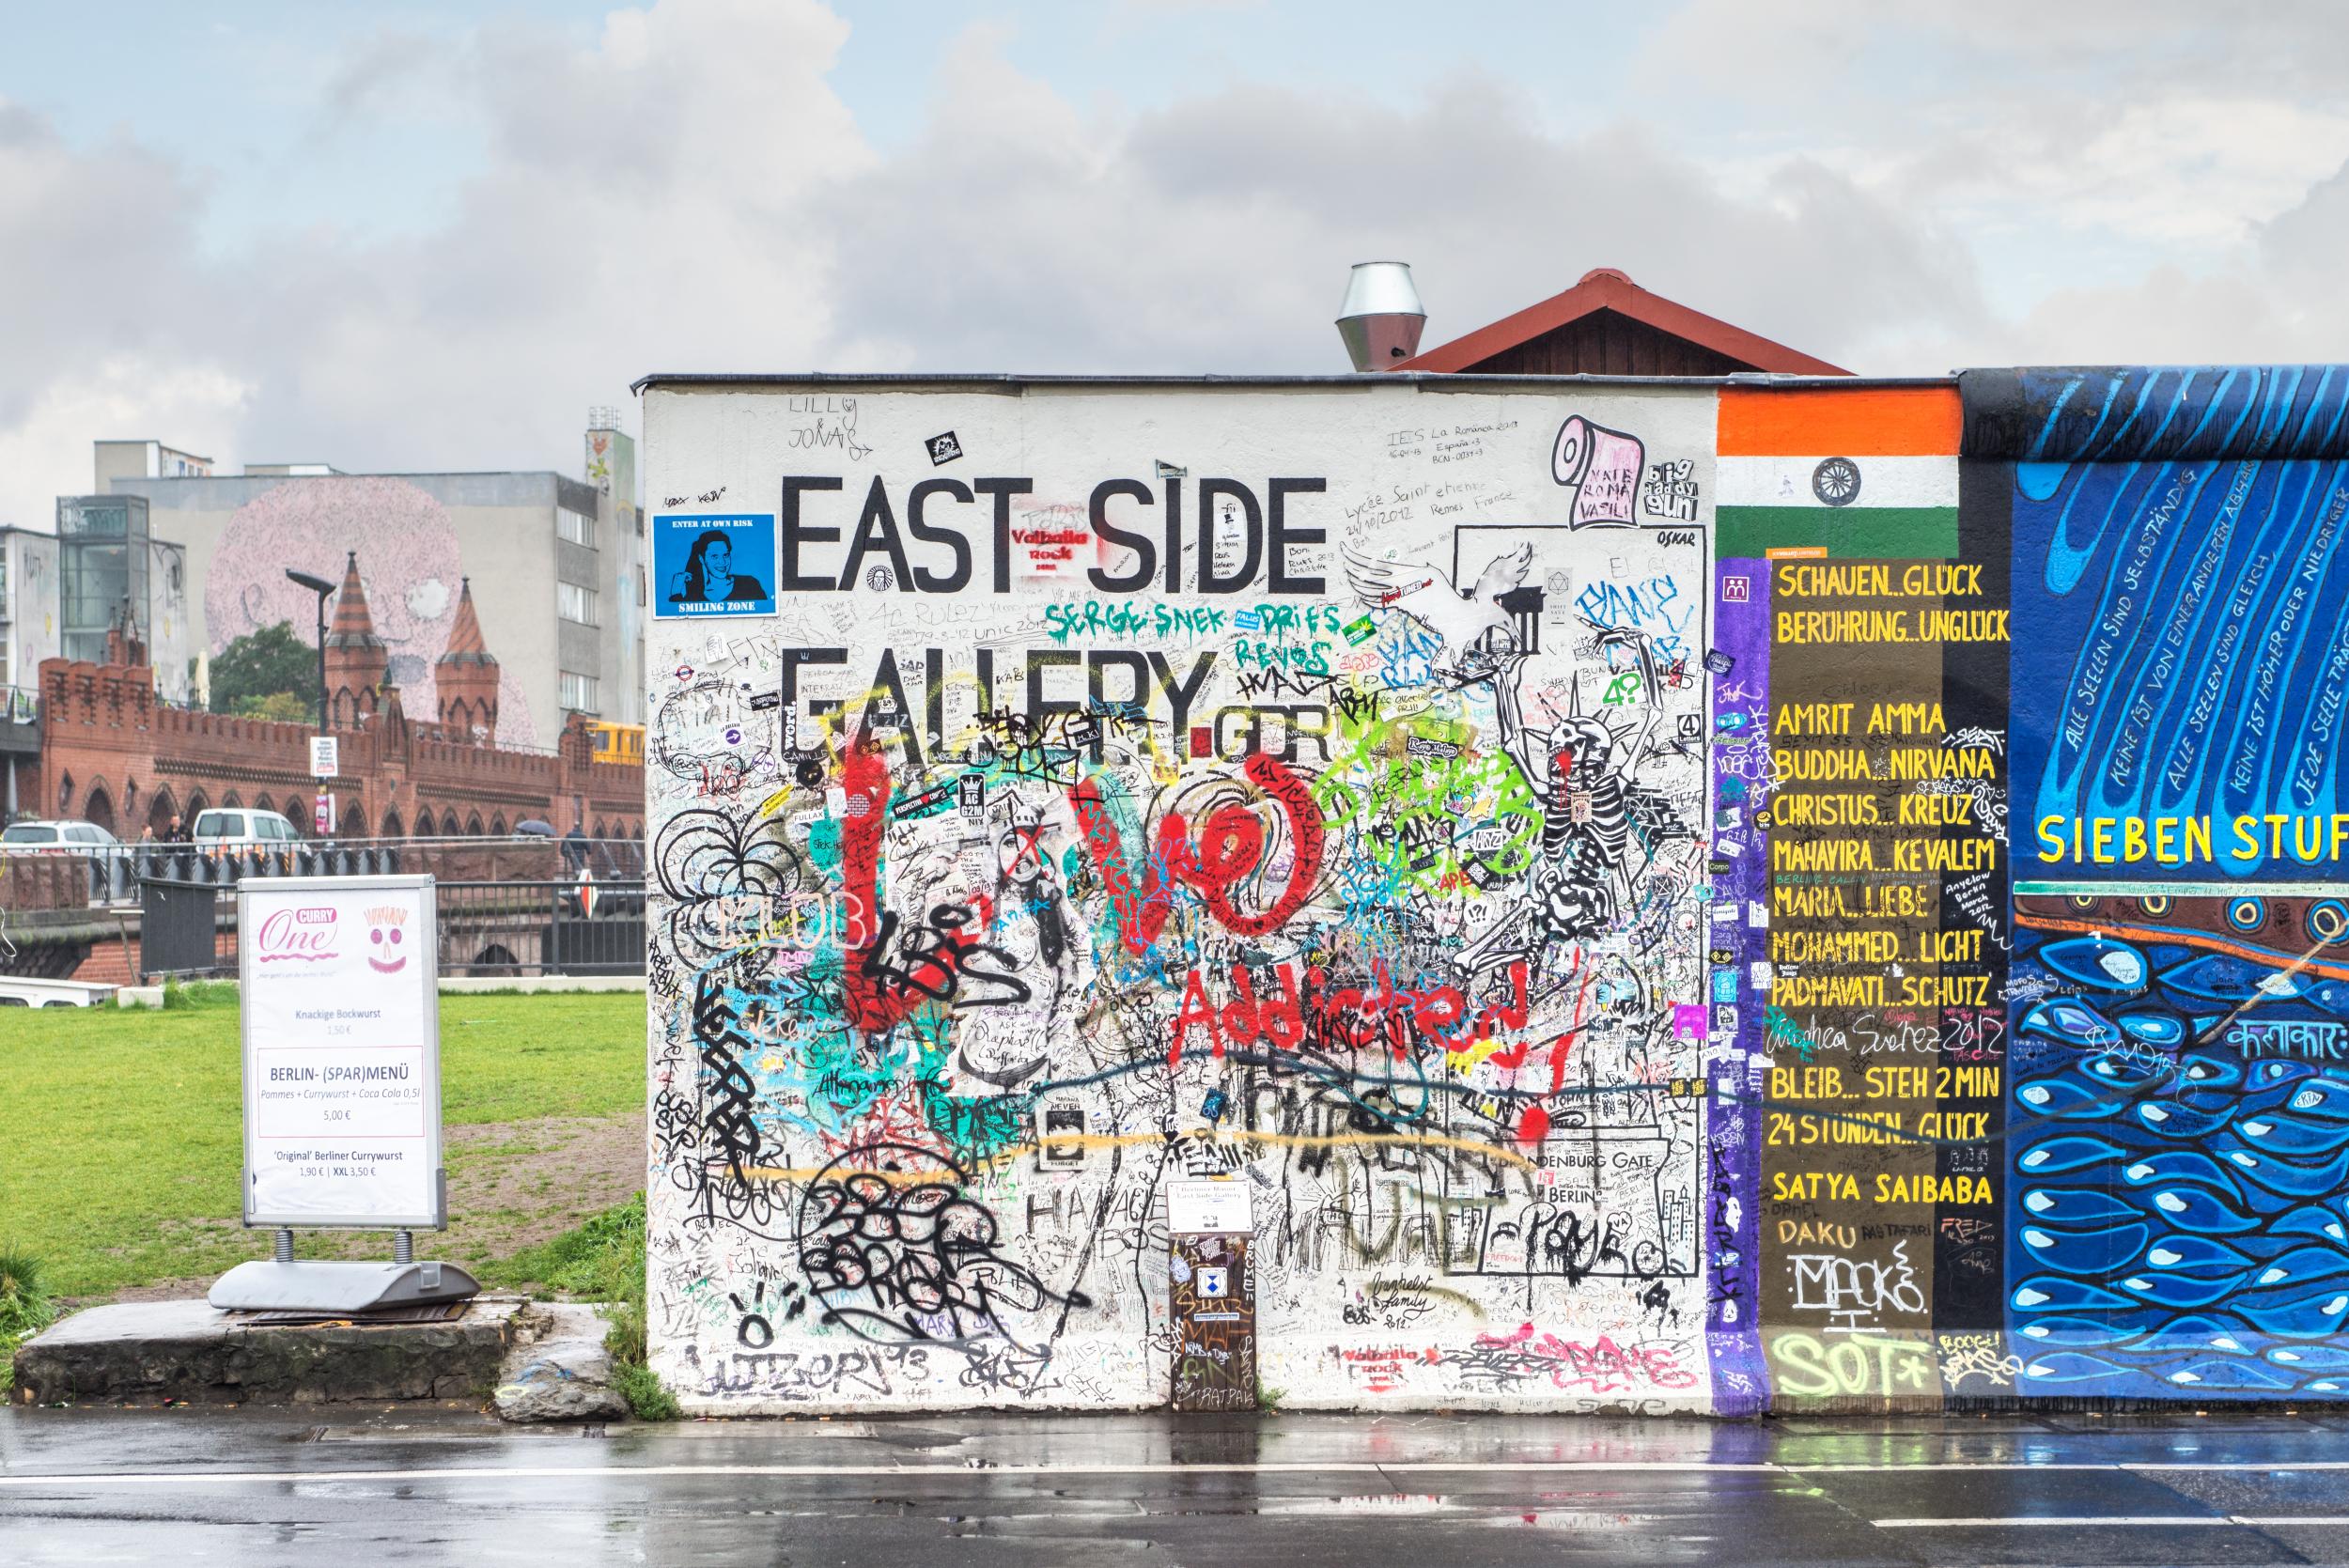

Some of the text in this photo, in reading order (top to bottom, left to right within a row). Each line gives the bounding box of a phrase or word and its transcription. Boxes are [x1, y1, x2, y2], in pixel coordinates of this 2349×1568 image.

[1648, 459, 1694, 482] big
[1644, 482, 1699, 497] daddy
[1645, 495, 1699, 520] gun
[782, 475, 1327, 594] EAST SIDE
[1657, 531, 1696, 548] OSKAR
[678, 601, 755, 613] SMILING ZONE
[2280, 586, 2308, 633] ODER
[2148, 645, 2174, 692] VON
[2066, 706, 2088, 753] ALLE
[2077, 640, 2112, 708] SEELEN
[1774, 703, 1946, 735] AMRIT AMMA
[2168, 737, 2195, 791] ALLE
[2195, 664, 2223, 734] SEELEN
[2295, 741, 2324, 808] JEDE
[2312, 683, 2342, 742] SEELE
[961, 805, 984, 817] G2M
[964, 794, 979, 805] AC
[1899, 793, 1972, 826] KREUZ
[794, 811, 824, 822] FULLAX
[2037, 815, 2212, 863] SIEBEN
[1709, 863, 1729, 872] Corpo
[299, 908, 334, 924] CURRY
[259, 908, 337, 952] One
[295, 1008, 381, 1021] Knackige Bockwurst
[1943, 1014, 2004, 1055] 2012
[271, 1063, 409, 1083] BERLIN- (SPAR)MENÜ
[1865, 1067, 1928, 1098] STEH
[1936, 1067, 1952, 1099] 2
[1956, 1067, 1999, 1098] MIN
[260, 1089, 295, 1099] Pommes
[303, 1088, 350, 1100] Currywurst
[359, 1088, 380, 1098] Coca
[381, 1088, 401, 1098] Cola
[323, 1110, 351, 1121] 5,00 €
[1768, 1112, 1796, 1145] 24
[315, 1151, 350, 1161] Berliner
[351, 1151, 403, 1162] Currywurst
[1611, 1151, 1654, 1169] GATE
[300, 1167, 377, 1177] 1,90 € XXL 3,50 €
[1549, 1188, 1595, 1203] BERLIN
[1773, 1172, 1993, 1204] SATYA SAIBABA
[1778, 1219, 1857, 1250] DAKU
[1379, 1289, 1437, 1321] family
